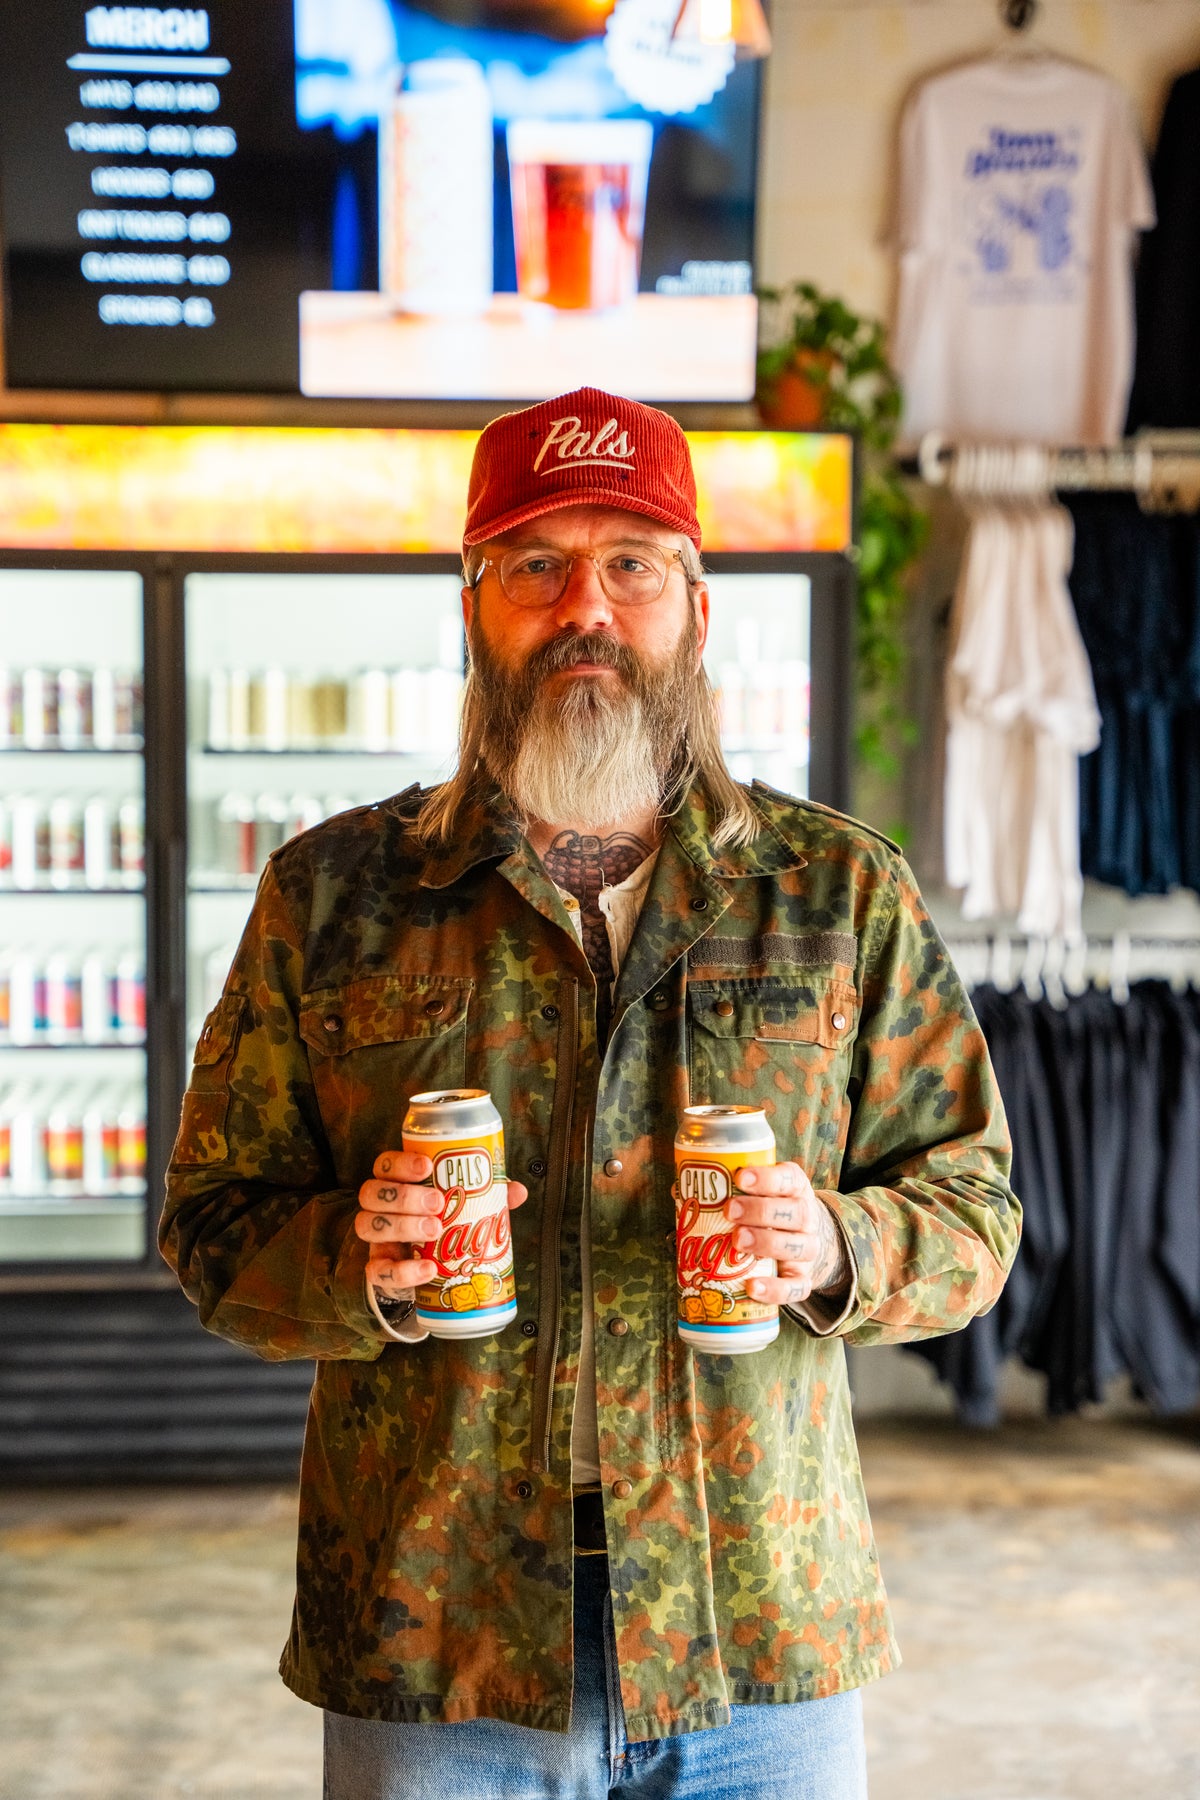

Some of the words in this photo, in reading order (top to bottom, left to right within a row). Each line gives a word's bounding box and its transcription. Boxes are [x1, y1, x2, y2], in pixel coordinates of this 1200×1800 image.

[86, 7, 209, 50] MERCH
[533, 416, 636, 473] Pals
[446, 1156, 483, 1188] PALS
[685, 1170, 718, 1201] PALS
